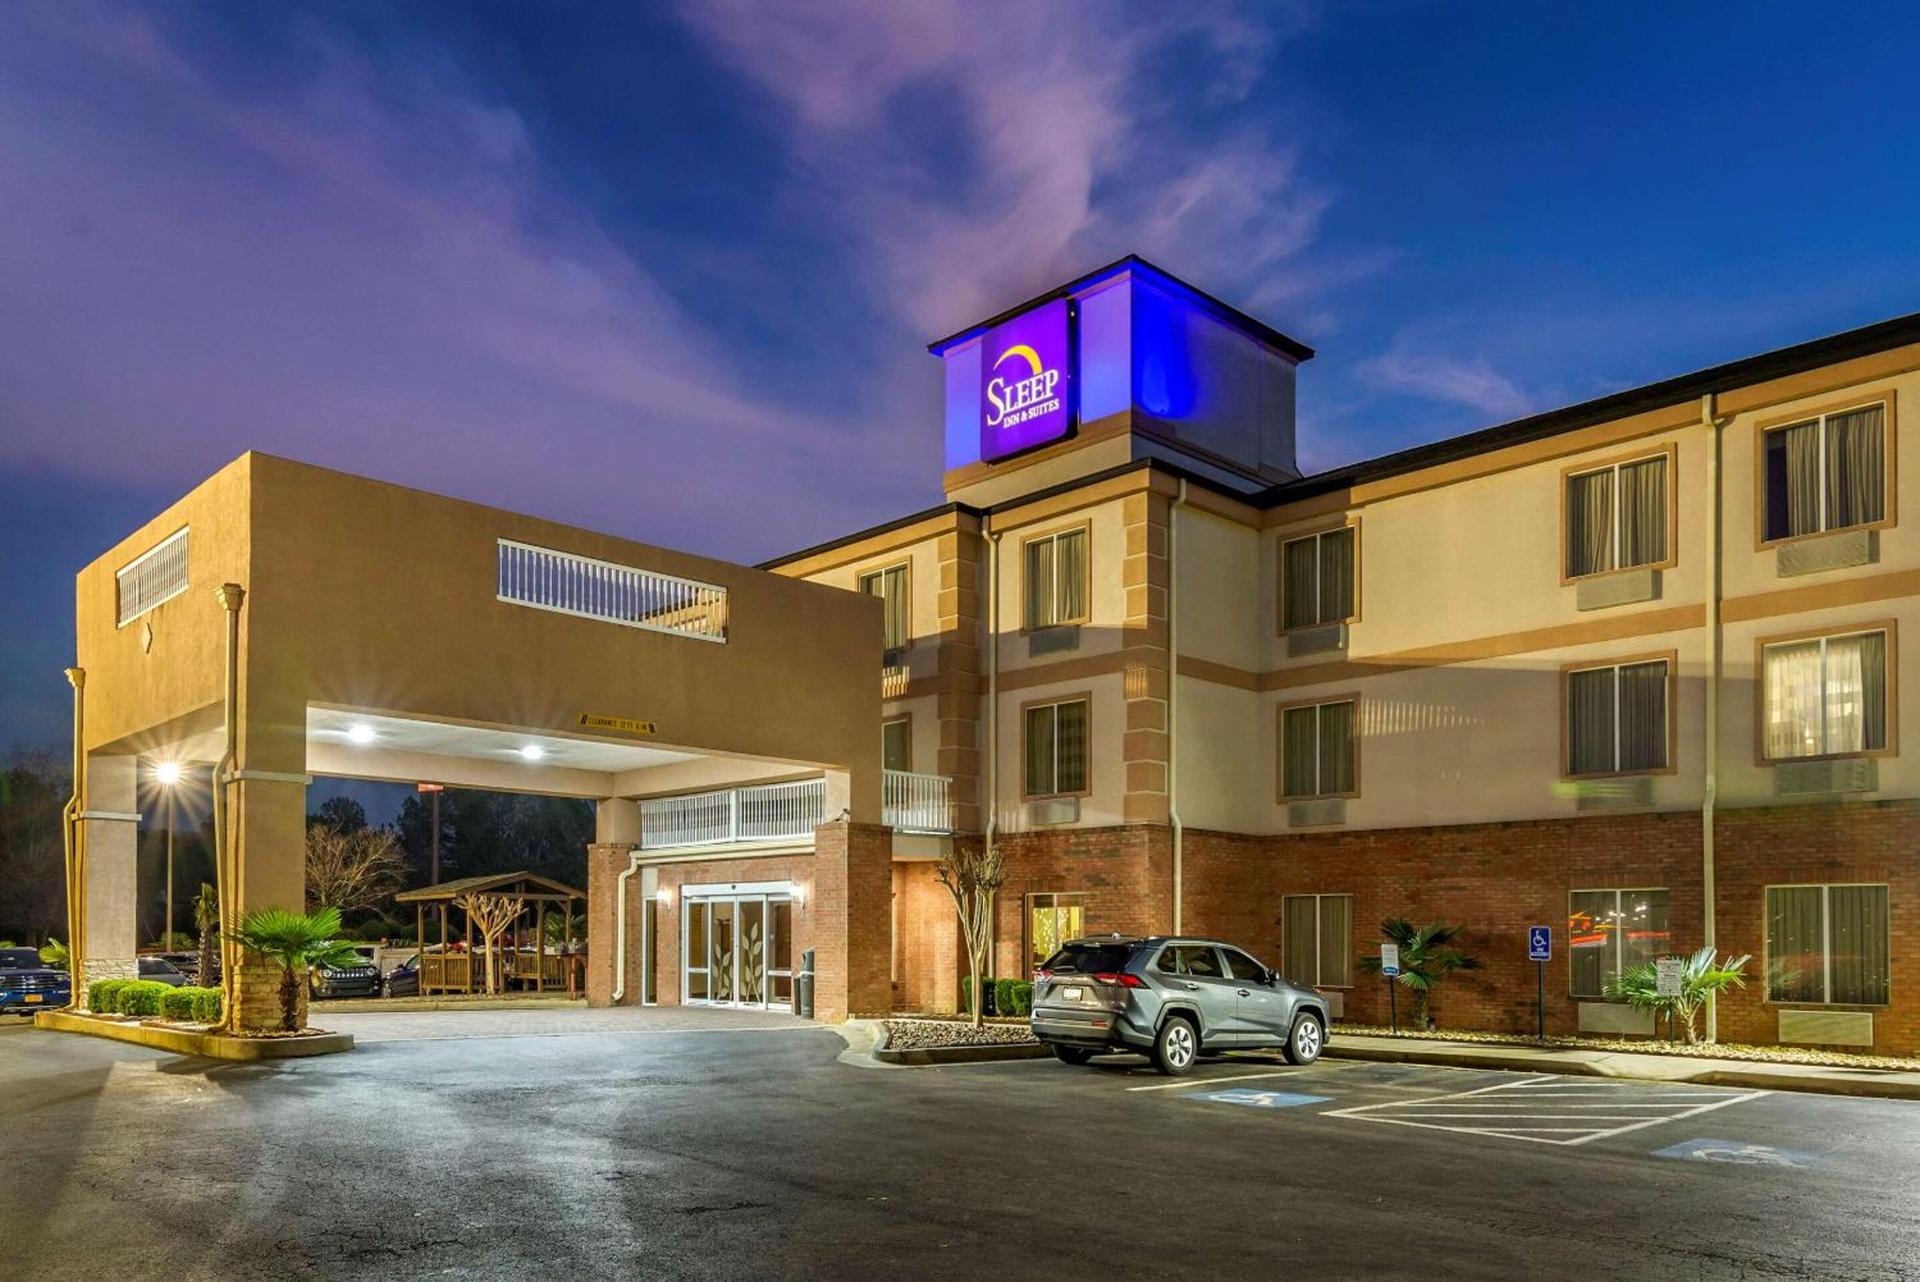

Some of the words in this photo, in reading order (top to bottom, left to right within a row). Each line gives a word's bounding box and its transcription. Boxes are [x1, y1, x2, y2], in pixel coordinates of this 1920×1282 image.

[987, 369, 1059, 426] SLEEP
[1003, 414, 1021, 429] INN
[1020, 410, 1028, 422] &
[1028, 398, 1059, 419] SUITES
